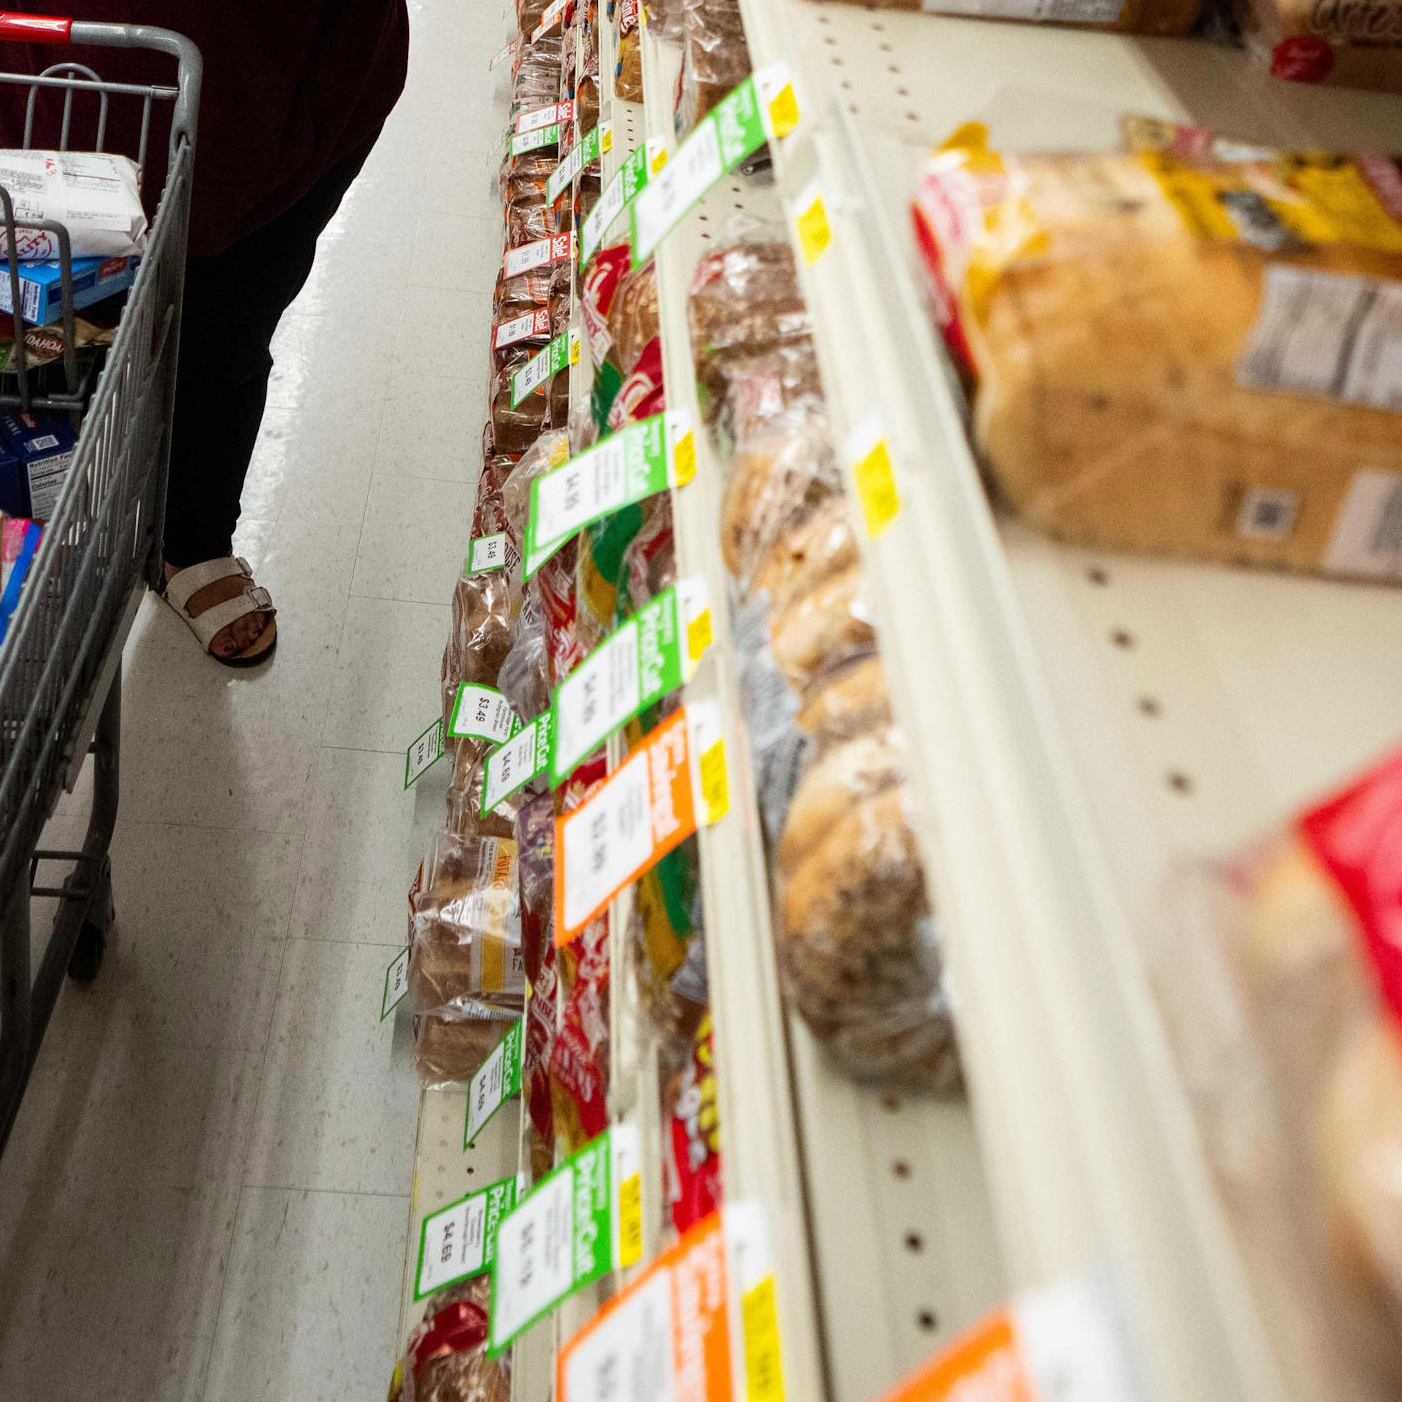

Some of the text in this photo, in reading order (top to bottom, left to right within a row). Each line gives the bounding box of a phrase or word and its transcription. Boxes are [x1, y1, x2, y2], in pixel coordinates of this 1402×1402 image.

[550, 234, 570, 260] Sale!
[475, 697, 490, 723] $3.49
[536, 712, 551, 772] PriceCut
[501, 751, 512, 783] $4.69
[502, 1029, 516, 1099] PriceCut
[571, 1153, 597, 1274] PriceCut
[440, 1221, 456, 1263] $4.69
